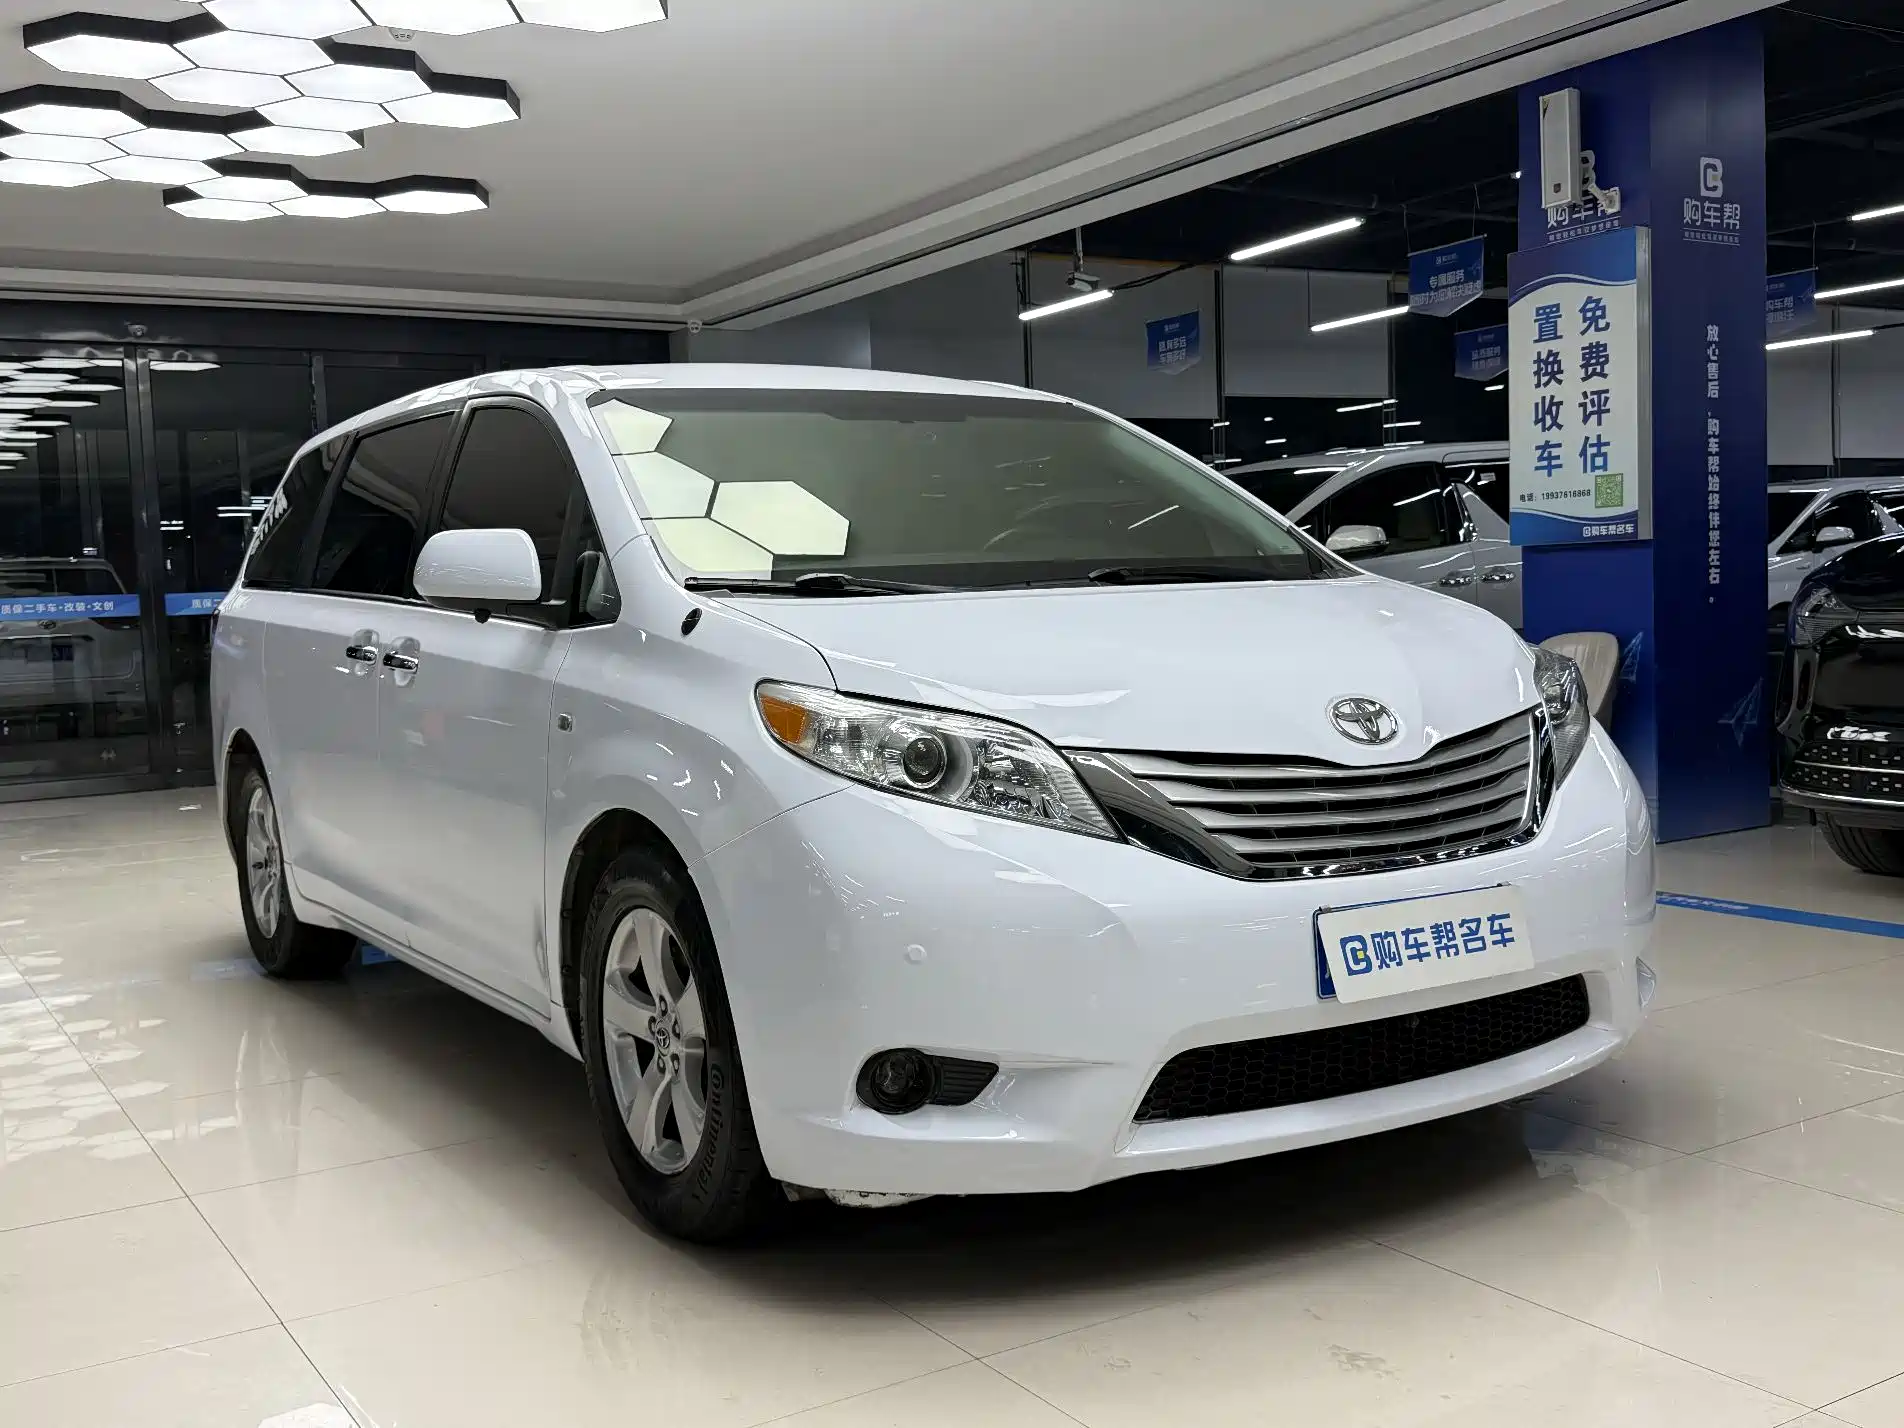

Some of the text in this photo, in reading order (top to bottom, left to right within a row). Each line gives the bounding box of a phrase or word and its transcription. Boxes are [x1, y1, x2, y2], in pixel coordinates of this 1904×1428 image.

[1684, 198, 1740, 229] 购车帮
[1532, 302, 1564, 478] 置换收车
[1578, 295, 1611, 474] 免费评估
[1591, 523, 1635, 536] 购车帮名车
[1370, 912, 1515, 971] 购车帮名车
